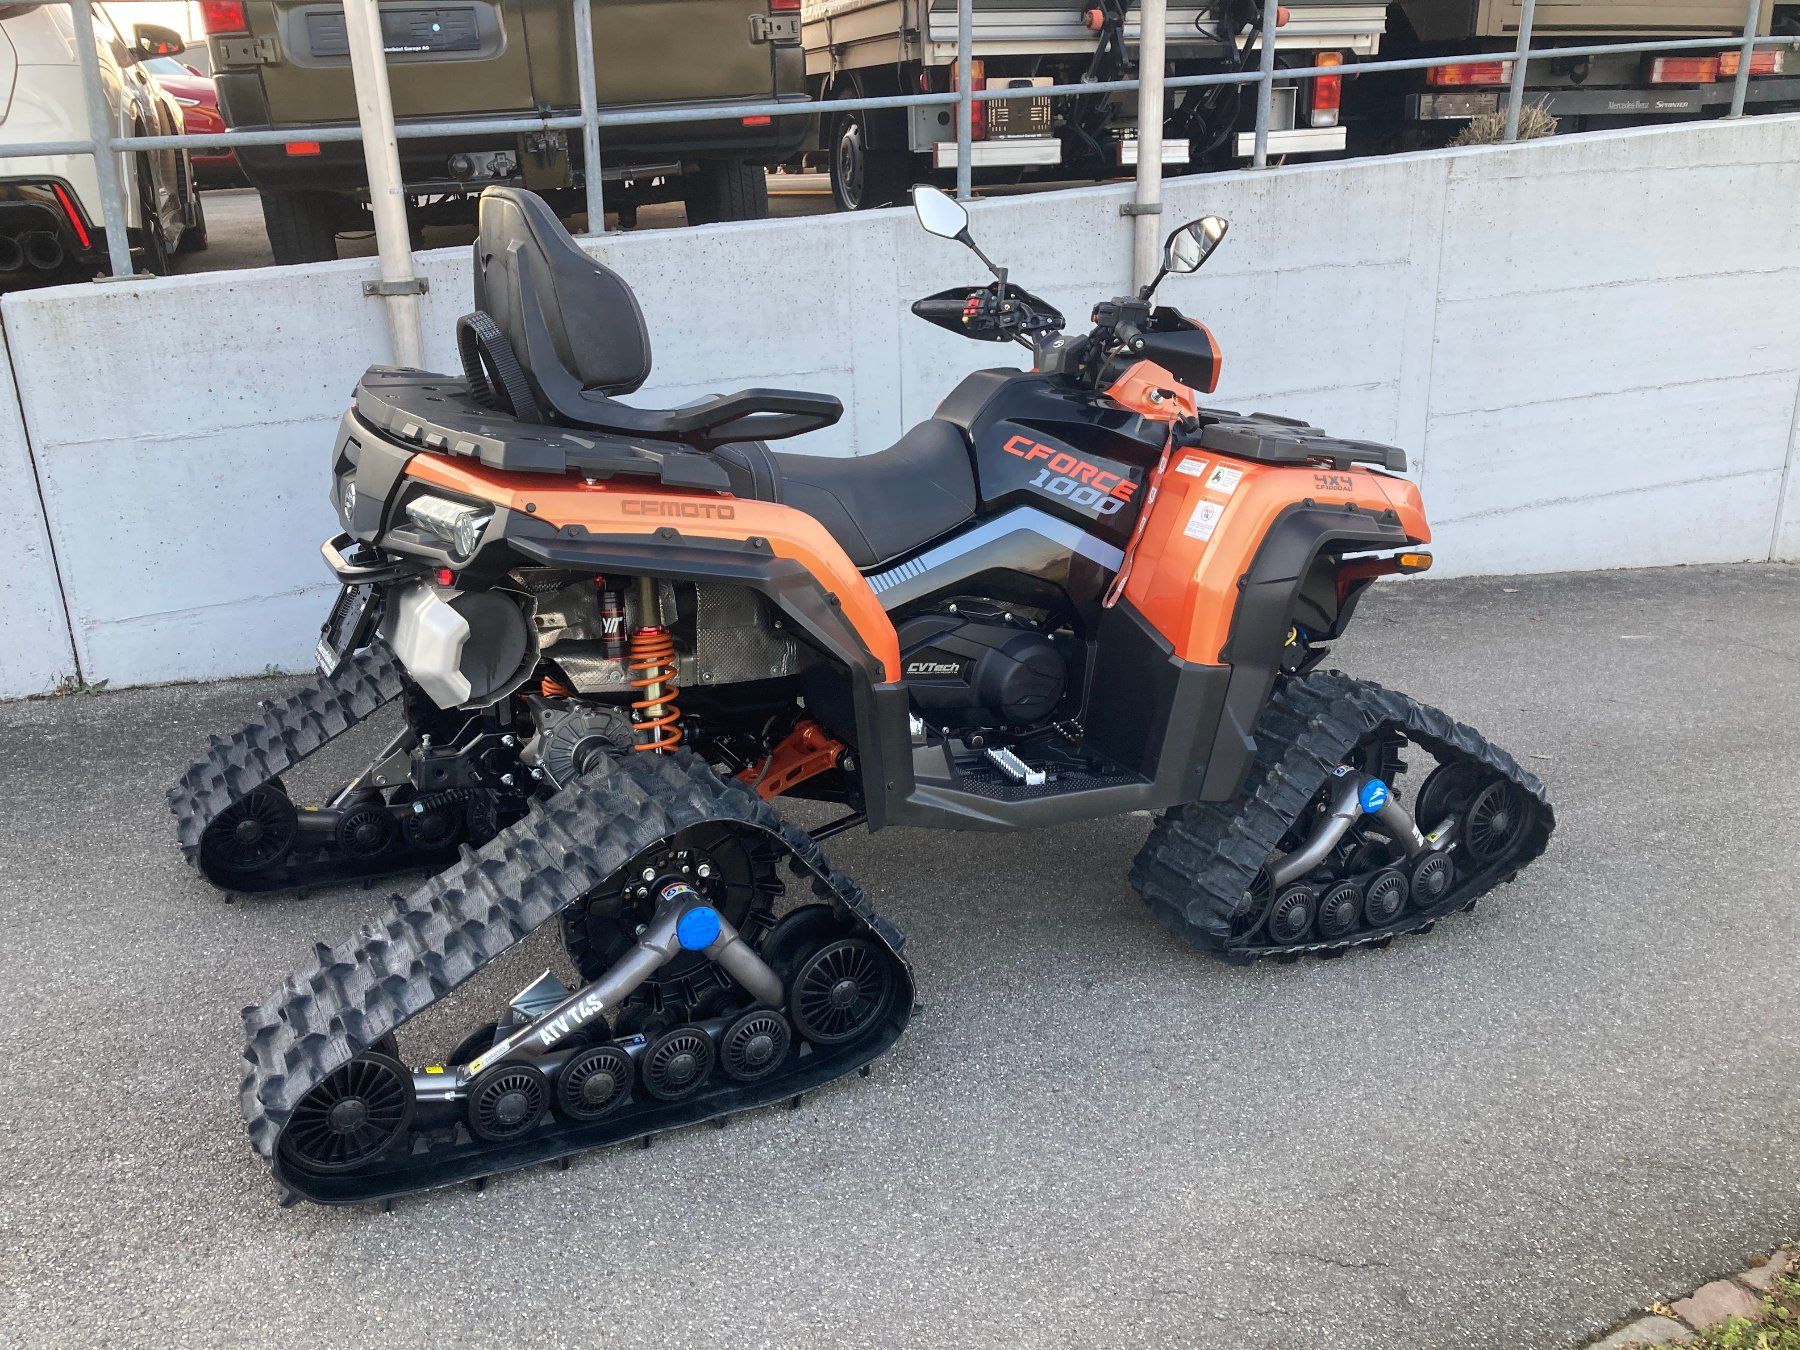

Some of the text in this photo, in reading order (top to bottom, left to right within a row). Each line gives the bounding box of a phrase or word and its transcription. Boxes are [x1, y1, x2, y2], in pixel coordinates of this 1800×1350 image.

[1003, 435, 1138, 502] CFORCE
[1028, 468, 1125, 515] 1000
[621, 500, 735, 520] CFMOTO
[908, 662, 960, 672] CVTech
[539, 993, 603, 1046] ATV T4S
